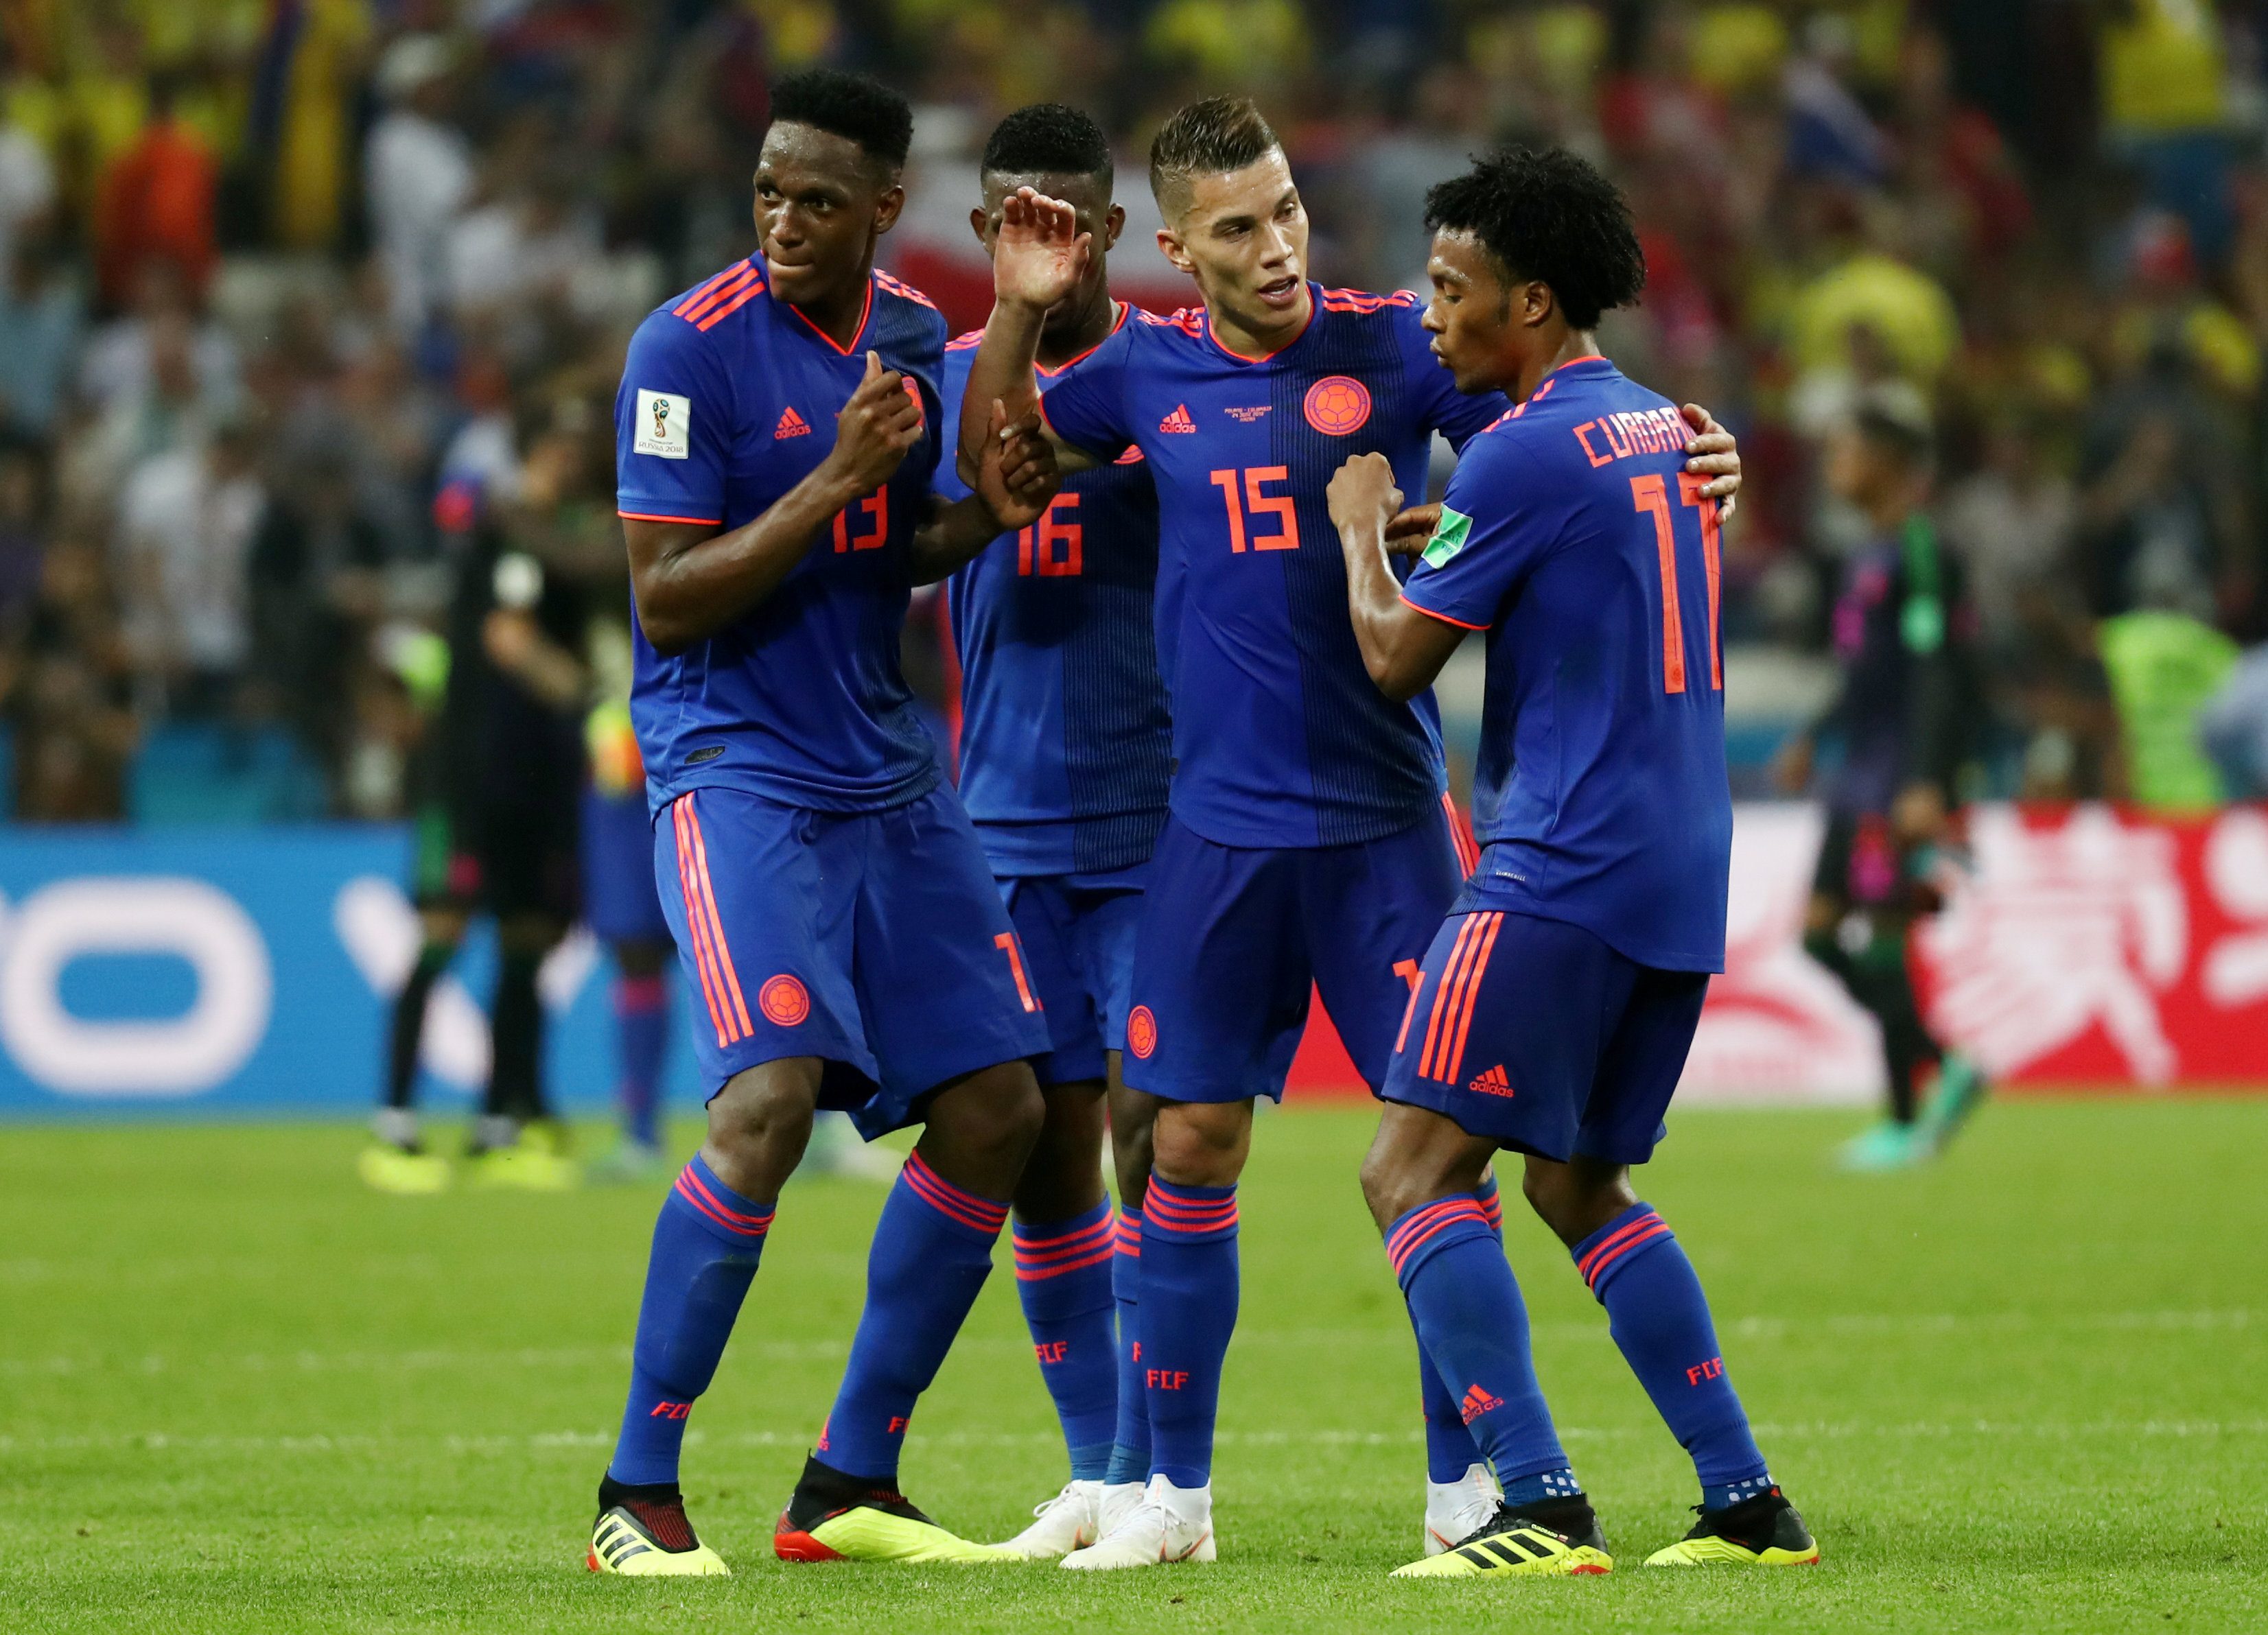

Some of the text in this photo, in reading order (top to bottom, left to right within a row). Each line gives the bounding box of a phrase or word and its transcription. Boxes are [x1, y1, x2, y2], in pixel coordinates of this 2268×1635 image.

[774, 425, 811, 440] adidas
[1160, 423, 1196, 433] adidas
[1573, 407, 1697, 468] CUADRA
[639, 441, 664, 451] RUSSIA
[1211, 465, 1300, 554] 15
[1018, 493, 1082, 576] 16
[1630, 471, 1722, 694] 11
[994, 932, 1044, 1013] 1
[1470, 1081, 1515, 1098] adidas
[1147, 1369, 1189, 1390] FCF
[1687, 1356, 1722, 1386] FCF
